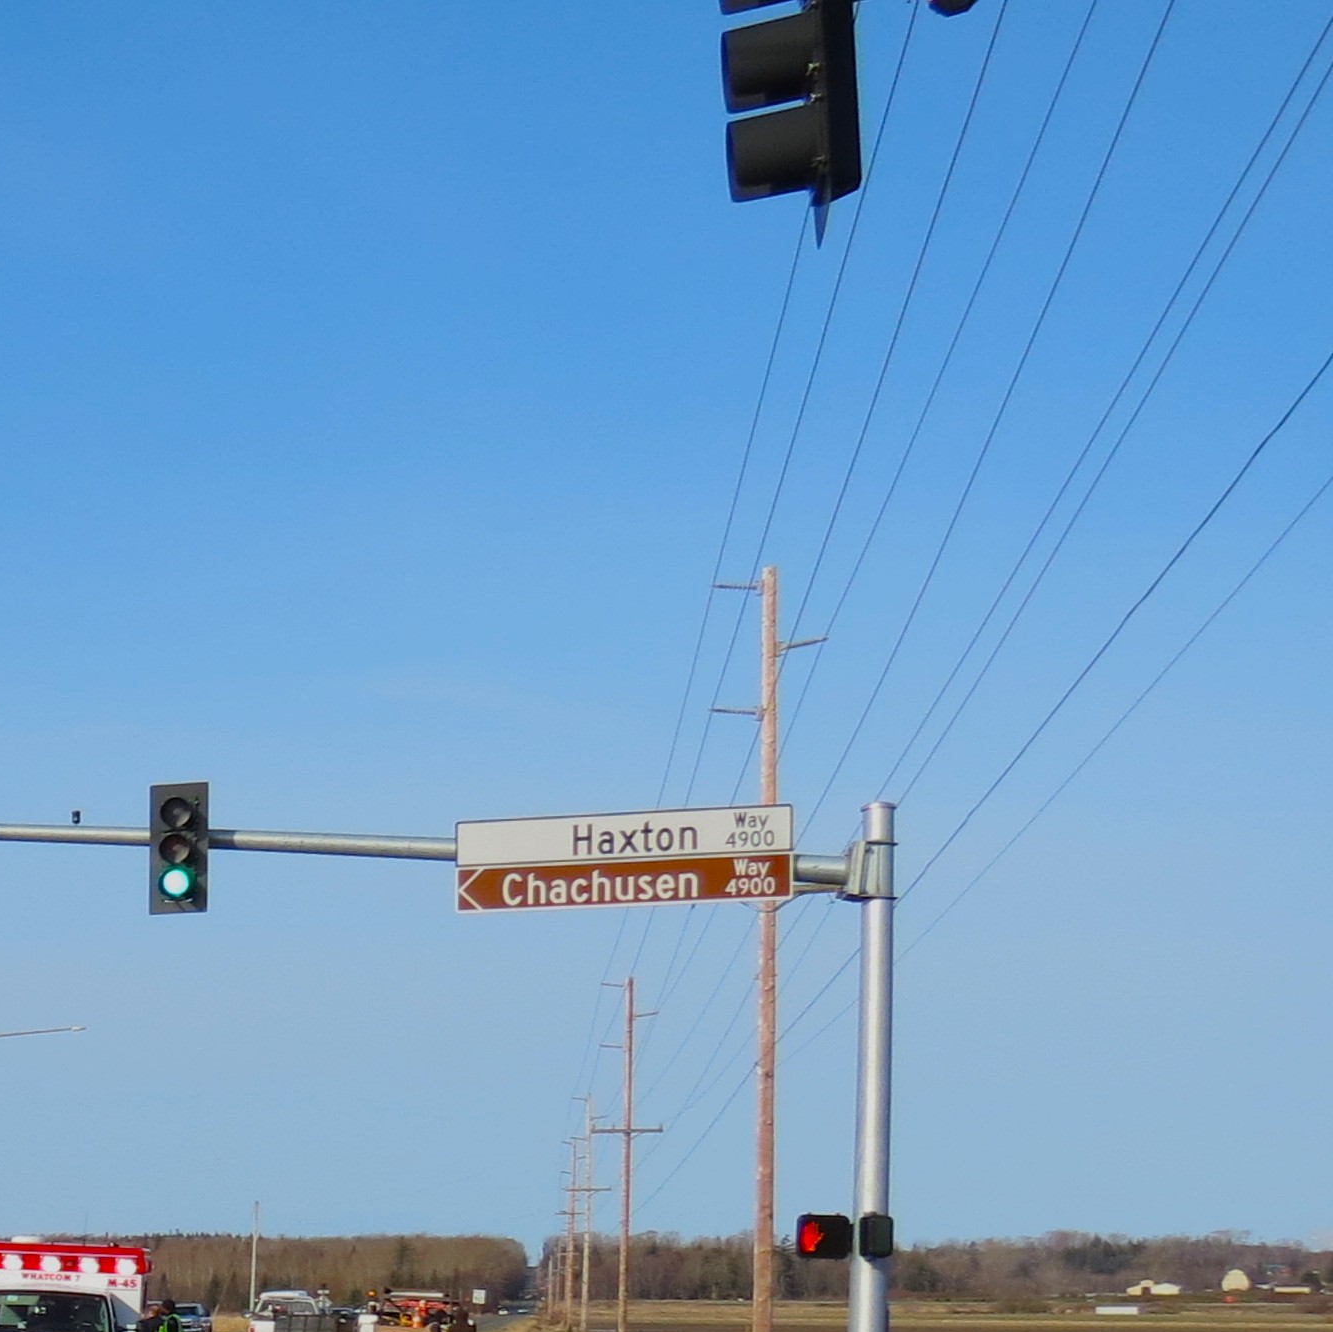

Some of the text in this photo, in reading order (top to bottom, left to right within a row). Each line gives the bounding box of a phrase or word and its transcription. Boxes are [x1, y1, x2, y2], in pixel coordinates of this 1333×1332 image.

[733, 812, 769, 829] Way
[572, 821, 698, 856] Haxton
[725, 830, 775, 848] 4900
[733, 858, 771, 878] Way
[502, 869, 698, 906] Chachusen
[724, 876, 776, 896] 4900
[22, 1272, 71, 1282] WHATCOM
